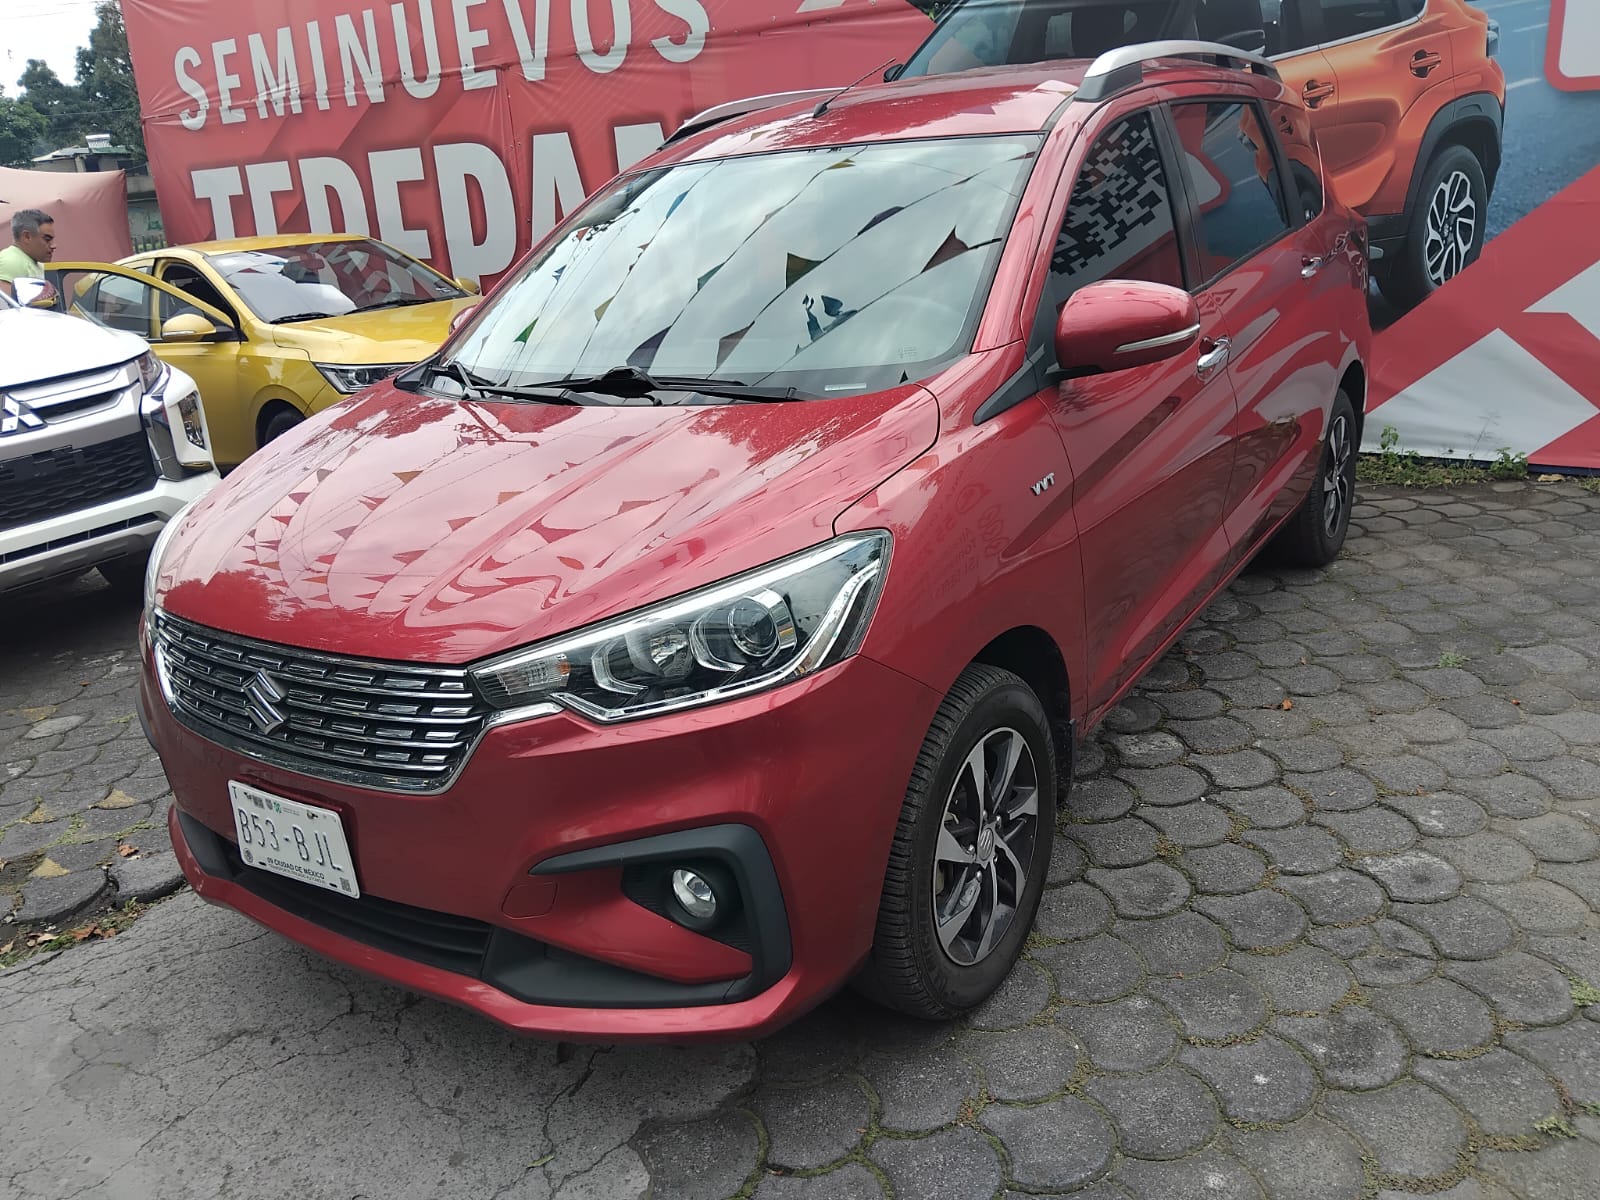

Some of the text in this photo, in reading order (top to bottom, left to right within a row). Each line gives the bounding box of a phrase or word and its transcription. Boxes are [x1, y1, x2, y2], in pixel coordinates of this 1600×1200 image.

[174, 0, 710, 131] SEMINUEVOS
[191, 123, 667, 282] TPEPA
[1030, 472, 1055, 496] VVT
[238, 808, 343, 872] B53-BJL
[274, 859, 294, 870] CIUDAD
